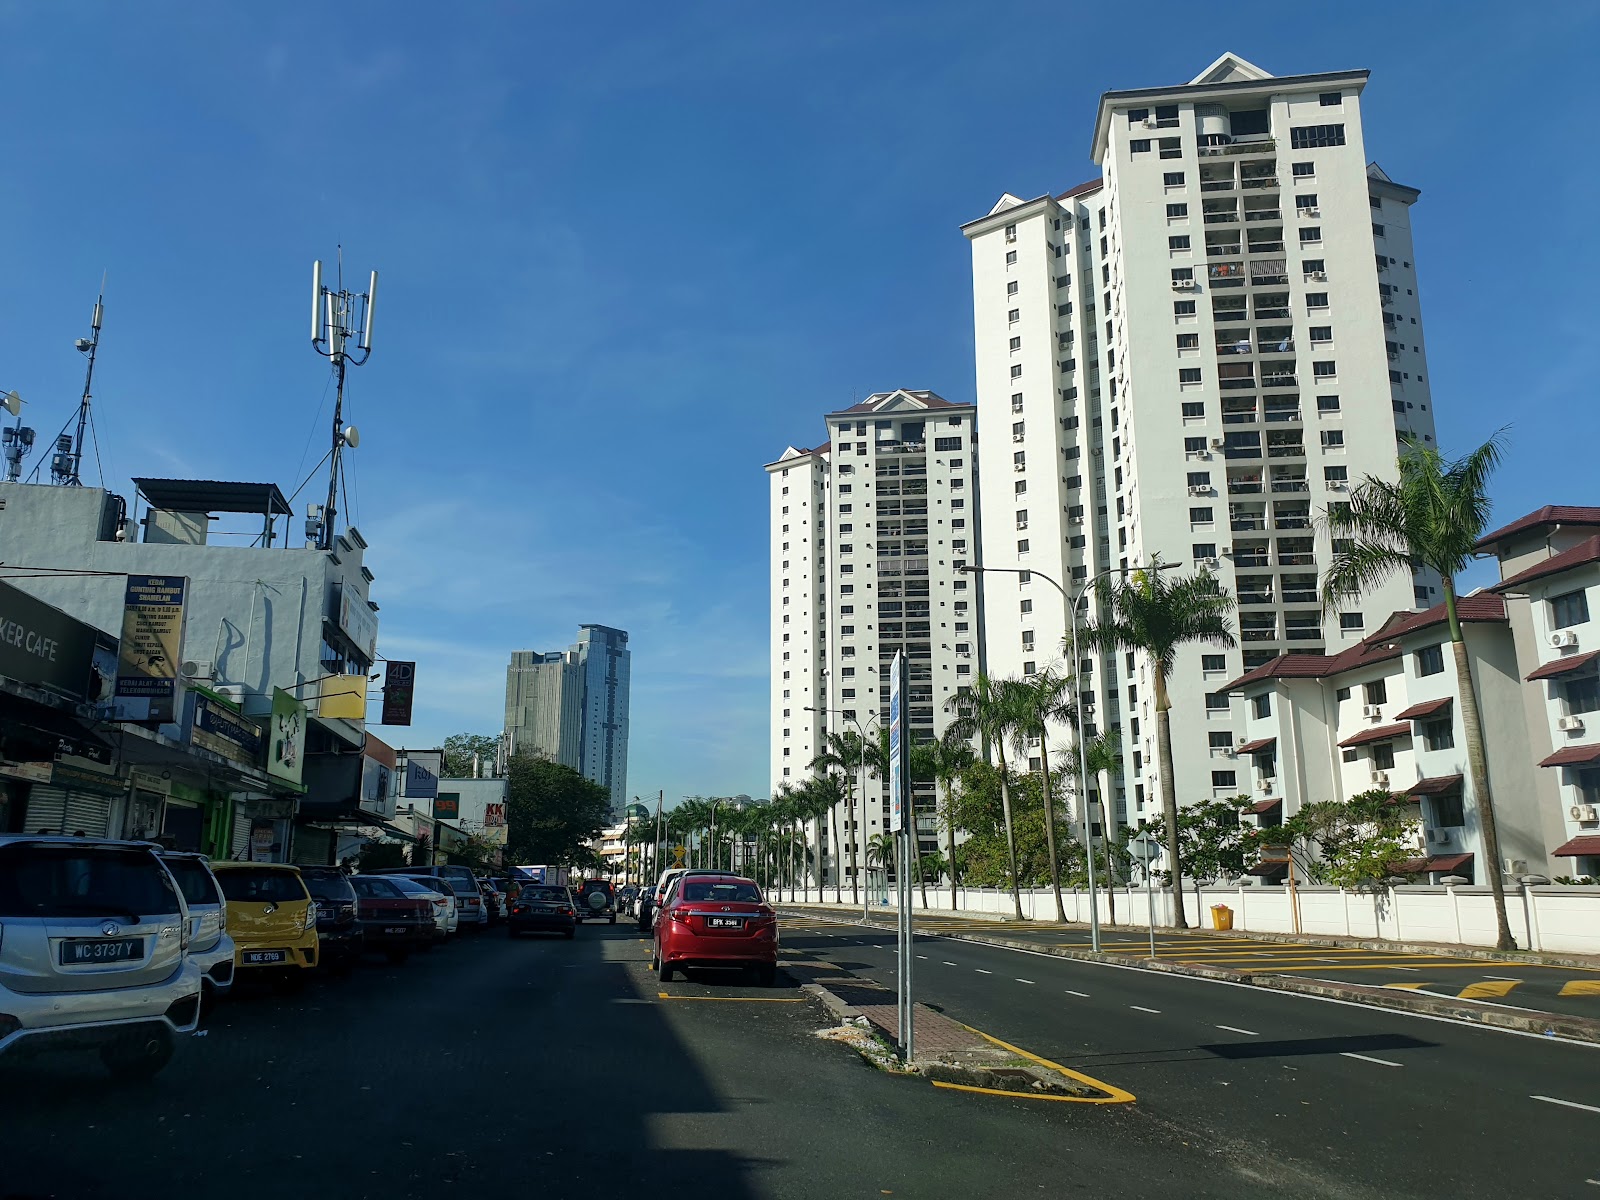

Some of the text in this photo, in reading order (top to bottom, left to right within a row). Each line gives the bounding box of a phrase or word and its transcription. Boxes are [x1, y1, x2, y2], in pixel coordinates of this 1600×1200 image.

[26, 631, 58, 662] CAFE
[389, 664, 412, 679] 4D
[435, 800, 456, 811] 99
[487, 804, 502, 815] KK
[75, 942, 133, 958] WC 3737 Y
